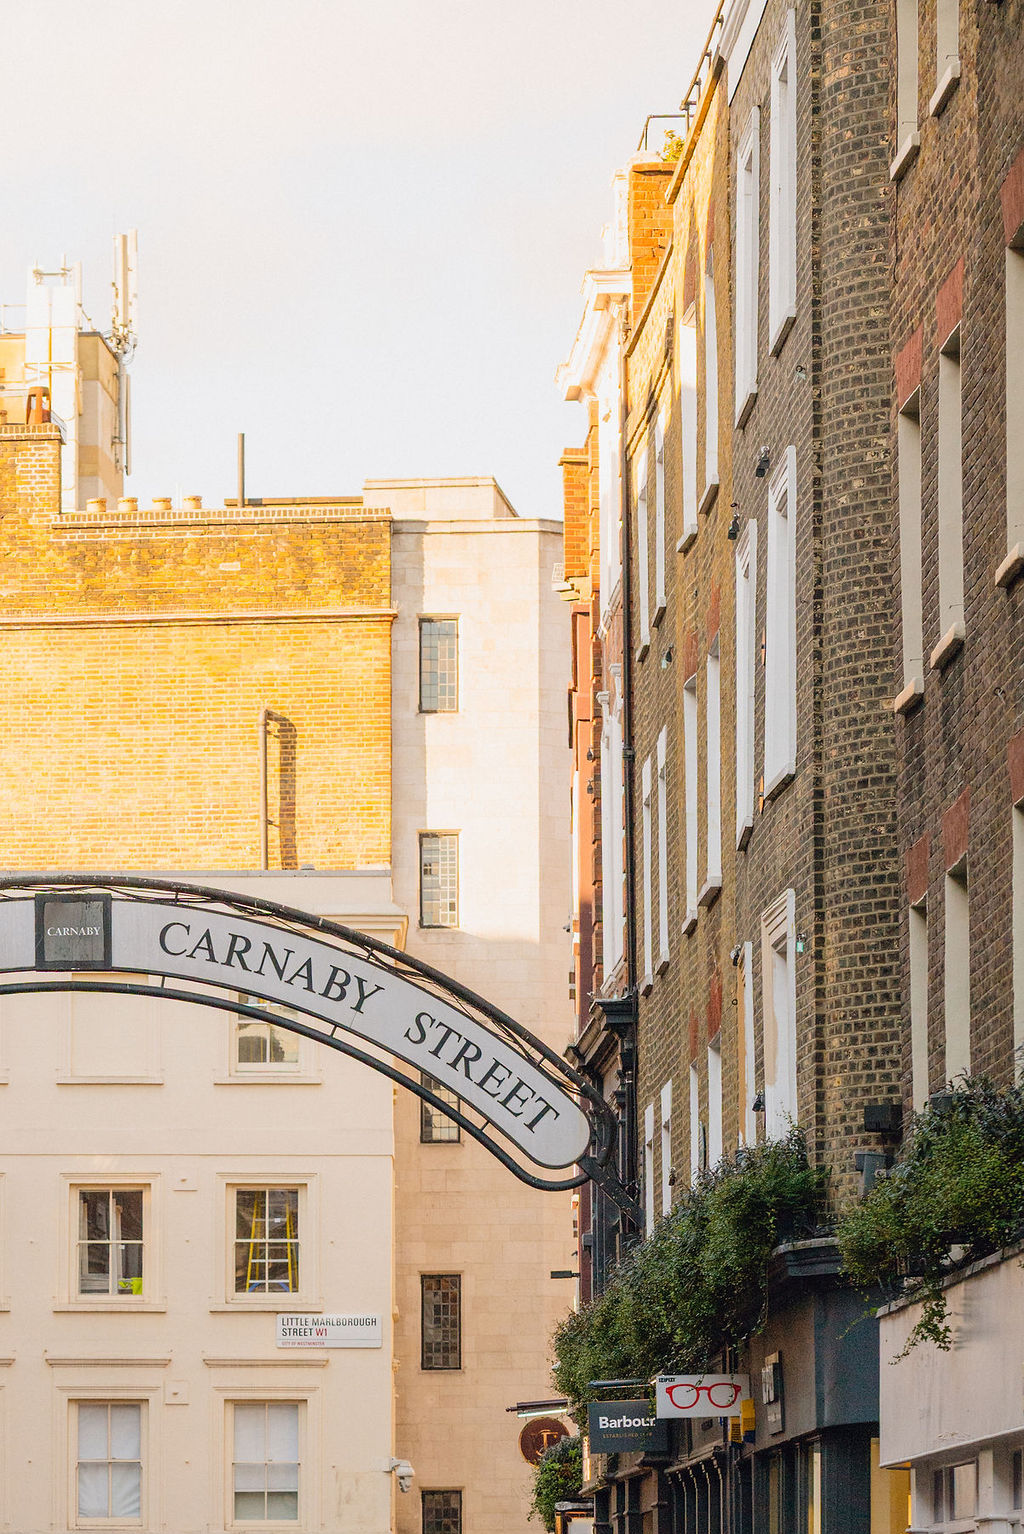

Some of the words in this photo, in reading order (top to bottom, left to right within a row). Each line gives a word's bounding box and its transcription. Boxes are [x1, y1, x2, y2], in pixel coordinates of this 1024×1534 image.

[47, 927, 100, 936] CARNABY
[159, 921, 385, 1014] CARNABY
[404, 1011, 560, 1134] STREET
[281, 1317, 309, 1326] LITTLE
[311, 1317, 377, 1326] MARLBOROUGH
[281, 1327, 313, 1336] STREET
[315, 1327, 328, 1336] W1
